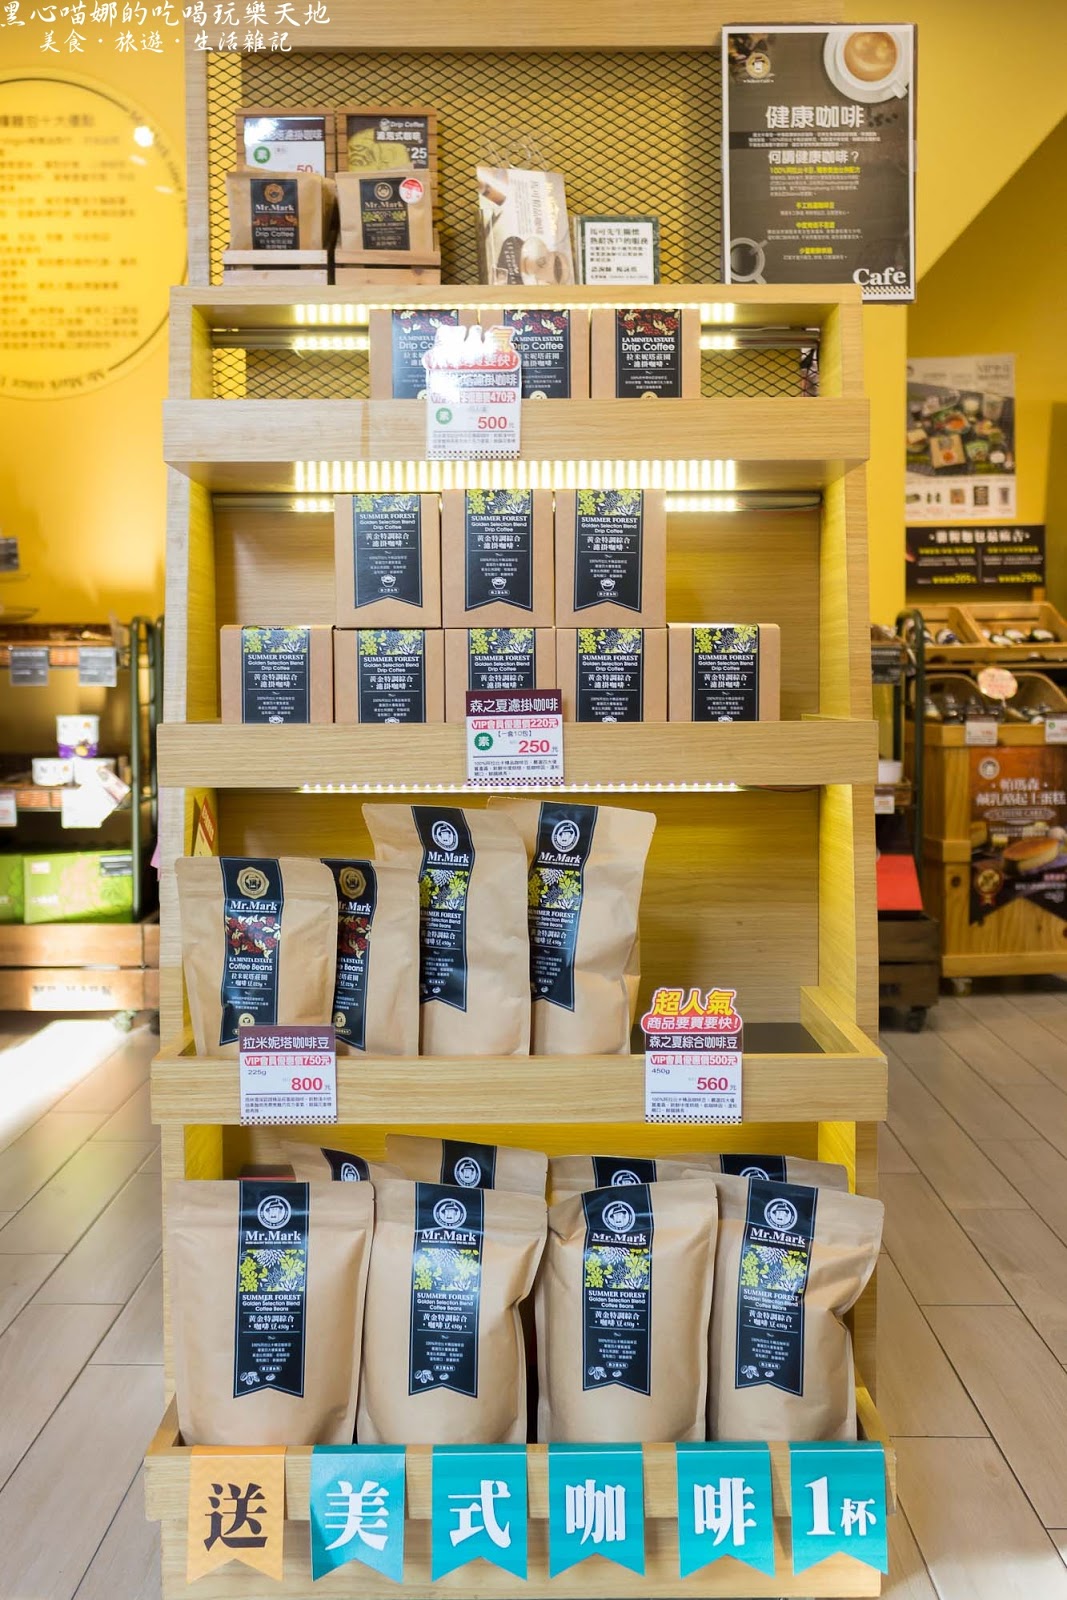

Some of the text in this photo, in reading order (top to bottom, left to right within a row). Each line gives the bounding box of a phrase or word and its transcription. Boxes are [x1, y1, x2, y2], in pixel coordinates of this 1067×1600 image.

[766, 105, 864, 128] 健康咖啡
[622, 343, 641, 352] Drip
[478, 417, 507, 429] 500
[470, 698, 558, 713] 森之夏濾掛咖啡
[478, 736, 489, 746] 素
[518, 740, 550, 753] 250
[427, 851, 469, 863] Mr.Mark
[539, 852, 581, 863] Mr.Mark
[230, 901, 277, 910] Mr.Mark
[344, 964, 363, 972] Beans
[652, 990, 734, 1015] 超人氣
[243, 1037, 329, 1049] 拉米妮塔咖啡豆
[649, 1036, 738, 1049] 森之夏綜合咖啡豆
[291, 1078, 322, 1091] 800
[697, 1077, 728, 1090] 560
[245, 1231, 301, 1240] Mr.Mark
[421, 1230, 476, 1242] Mr.Mark
[592, 1232, 646, 1243] Mr.Mark
[751, 1227, 806, 1245] Mr.Mark
[744, 1289, 798, 1301] SUMMER FOREST
[423, 1313, 467, 1322] 黃金特調綜合
[595, 1311, 640, 1320] 黃金特調綜合
[749, 1310, 792, 1323] 黃金特調綜合
[204, 1482, 269, 1550] 送
[325, 1480, 389, 1552] 美
[448, 1479, 511, 1548] 式
[564, 1479, 626, 1546] 咖
[692, 1478, 756, 1547] 啡
